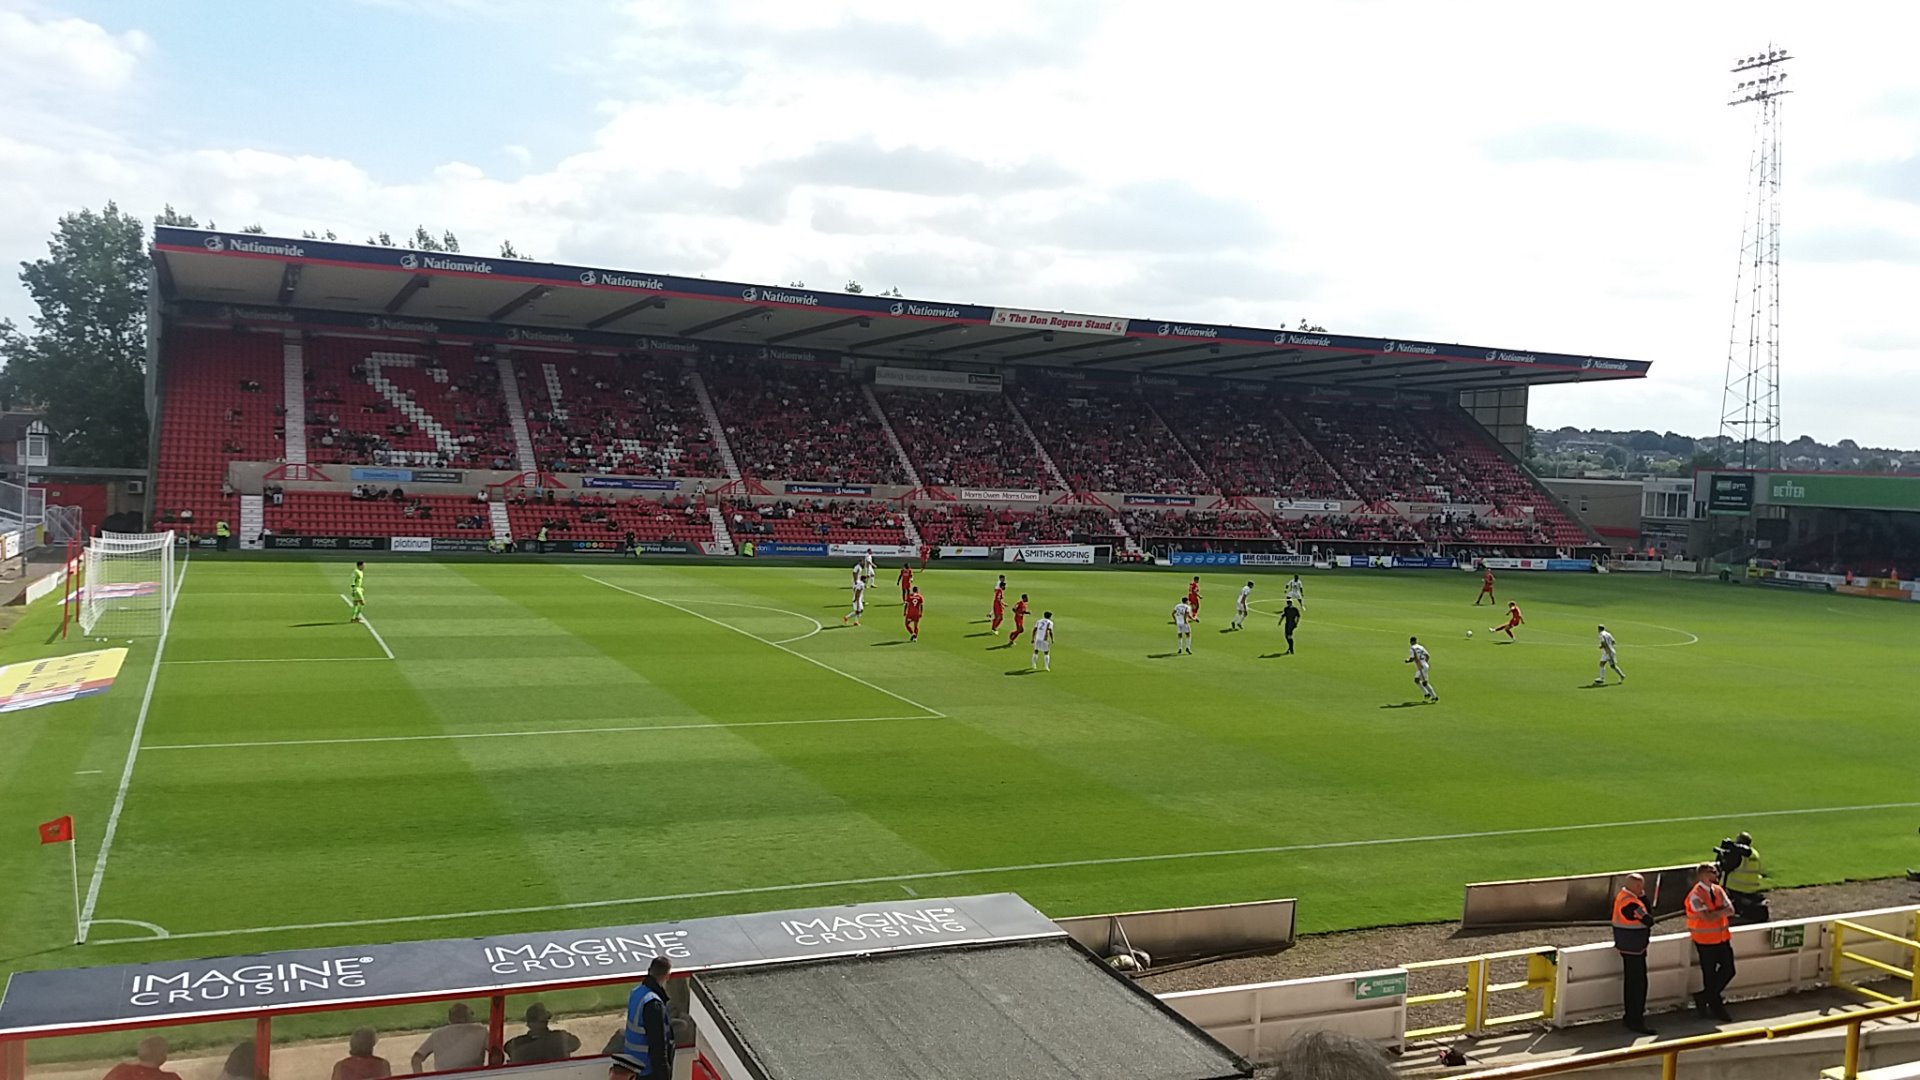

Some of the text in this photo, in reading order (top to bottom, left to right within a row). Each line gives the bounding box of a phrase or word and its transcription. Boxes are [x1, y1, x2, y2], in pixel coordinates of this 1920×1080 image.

[230, 239, 304, 257] Nationwide
[424, 257, 492, 274] Nationwide
[601, 274, 663, 290] Nationwide
[762, 291, 818, 306] Nationwide
[907, 304, 960, 319] Nationwide
[1008, 313, 1112, 330] The Don Rogers Stand
[1172, 326, 1217, 339] Nationwide
[1288, 335, 1331, 347] Nationwide
[1397, 343, 1437, 354] Nationwide
[1498, 352, 1536, 363] Nationwide
[1020, 493, 1037, 501] Owen
[1773, 485, 1805, 498] BETTER
[393, 538, 430, 550] platinum
[1024, 549, 1090, 559] SMITHS ROOFING
[1242, 553, 1255, 561] DAVE
[1271, 554, 1301, 562] TRANSPORT
[912, 598, 918, 607] 9
[781, 908, 949, 936] IMAGINE
[795, 920, 966, 945] CRUISING
[484, 932, 681, 963] IMAGINE
[491, 946, 692, 974] CRUISING
[132, 957, 364, 993] IMAGINE
[1372, 977, 1406, 987] EMERGENCY
[130, 975, 366, 1006] CRUISING
[1382, 985, 1395, 993] EXIT
